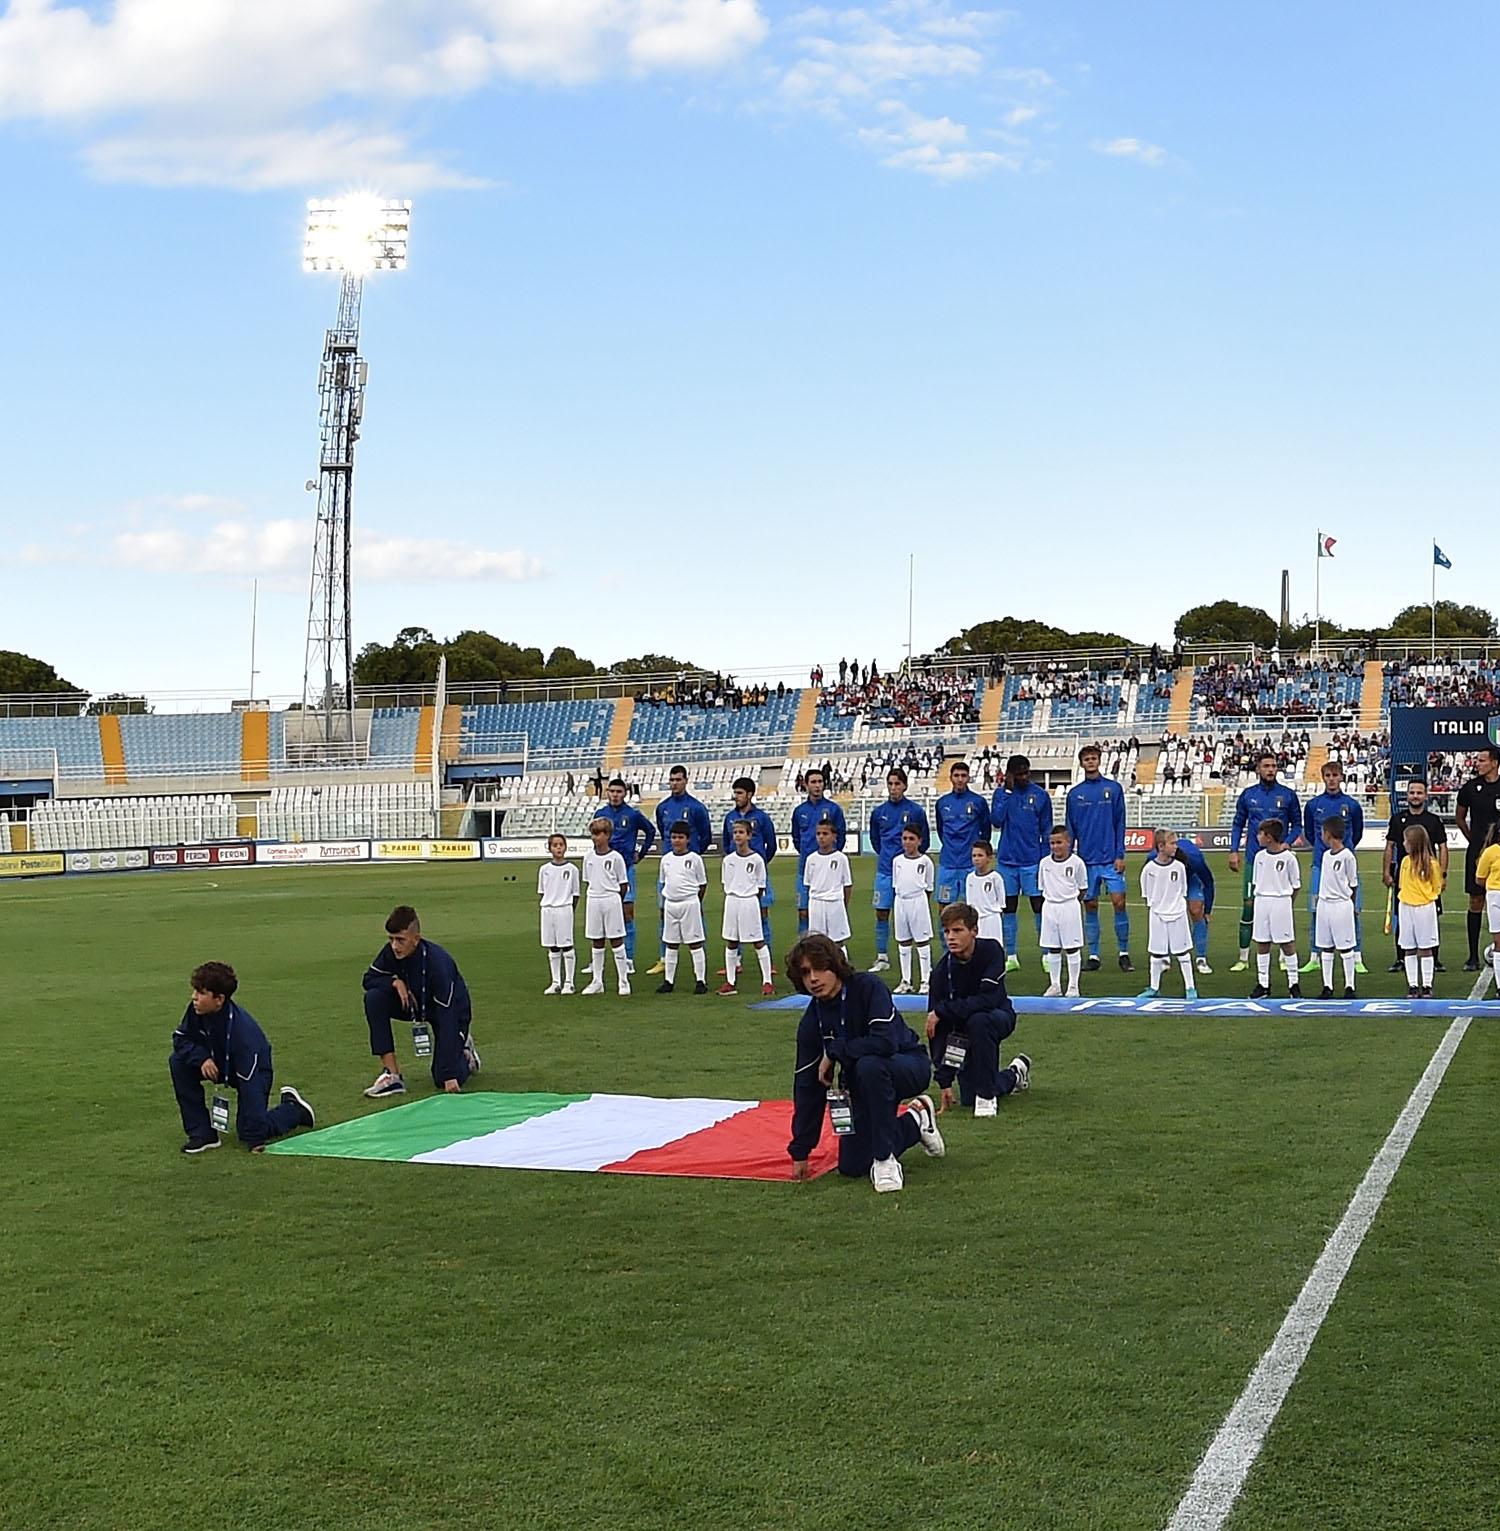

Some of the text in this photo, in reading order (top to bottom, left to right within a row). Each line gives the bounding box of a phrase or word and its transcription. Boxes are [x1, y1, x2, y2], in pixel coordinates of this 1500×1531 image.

[1433, 721, 1484, 734] ITALIA
[1124, 832, 1145, 845] ete
[155, 852, 177, 861] PERONI
[185, 851, 209, 860] PERONI
[219, 849, 247, 859] PERONI
[1070, 999, 1412, 1013] PEACE
